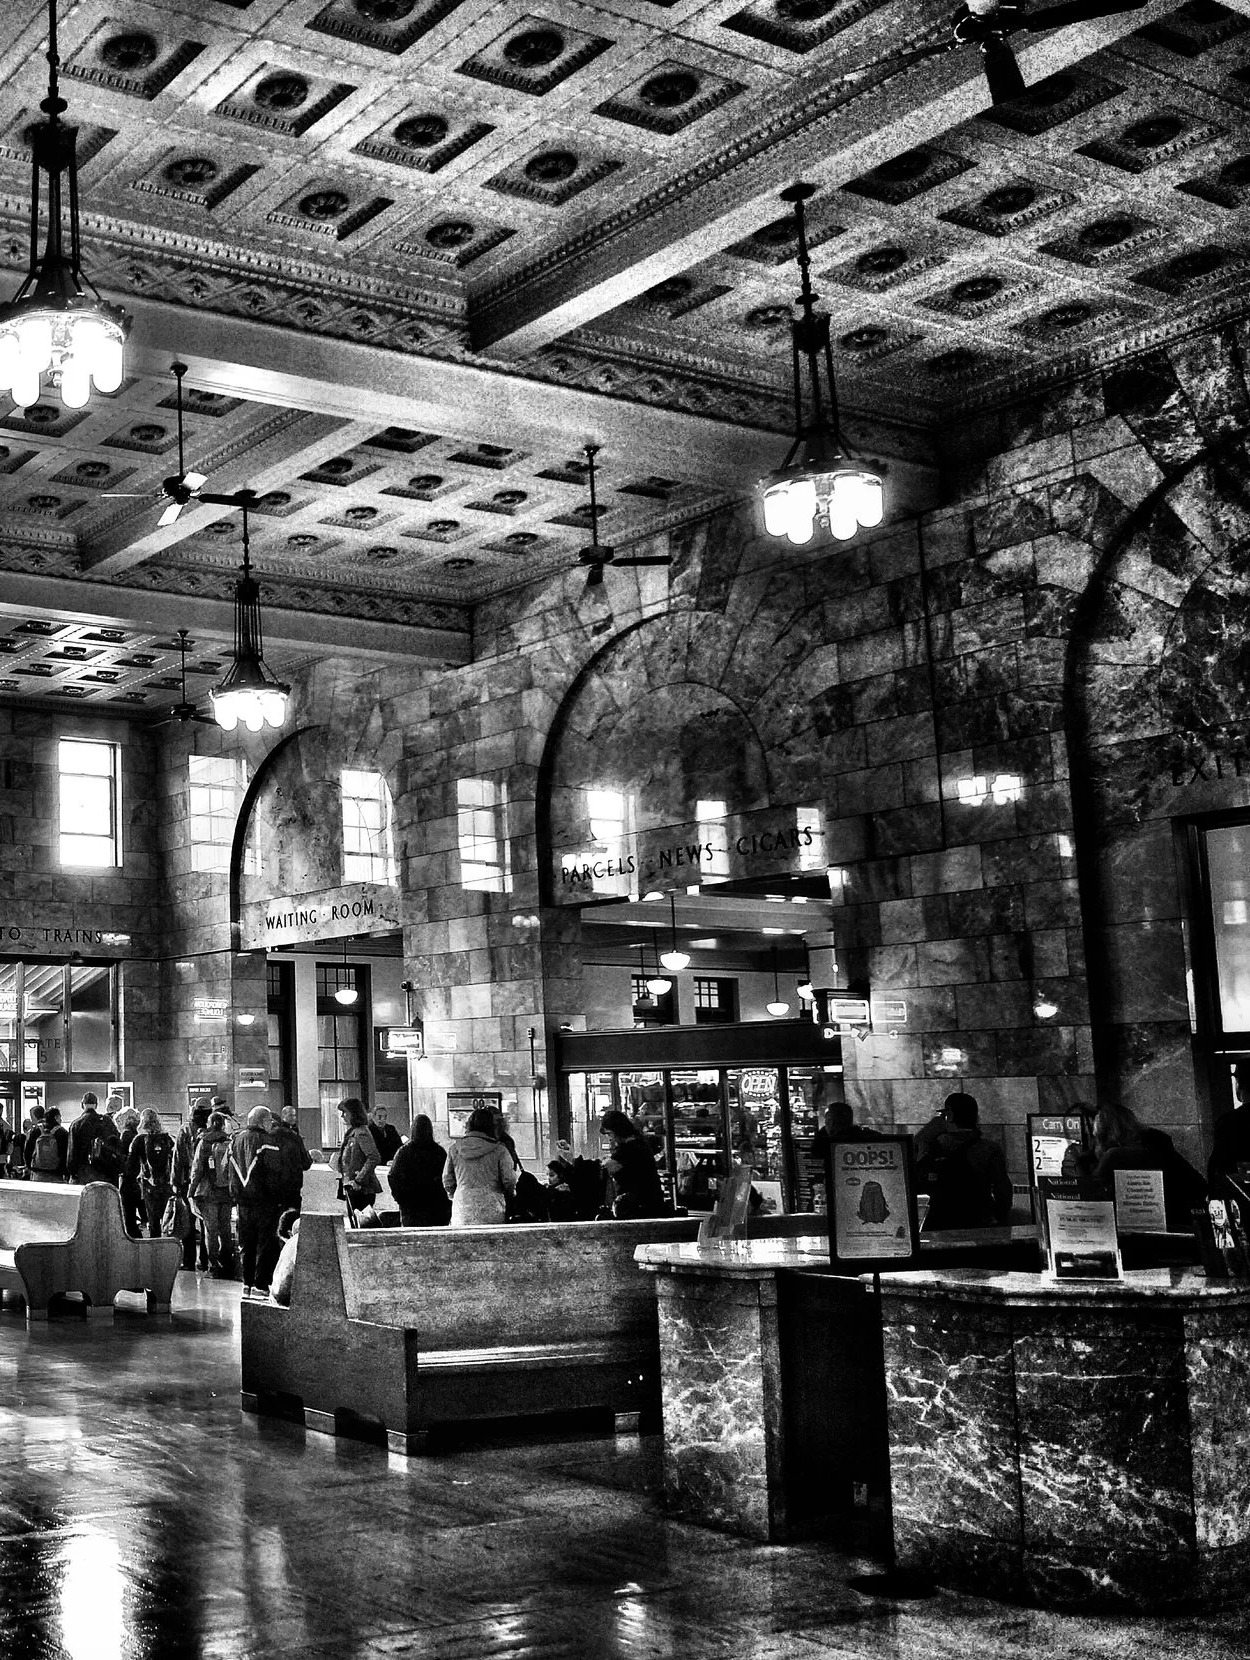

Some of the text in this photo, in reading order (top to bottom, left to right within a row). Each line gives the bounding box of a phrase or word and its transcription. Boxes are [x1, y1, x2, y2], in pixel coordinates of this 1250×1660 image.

[1172, 752, 1245, 786] EXIT
[561, 826, 812, 884] PARCELS NEWS CIGARS
[266, 899, 373, 929] WAITING ROOM
[43, 928, 102, 944] TRAINS
[28, 1039, 61, 1049] GATE
[40, 1051, 47, 1063] 5
[742, 1076, 777, 1093] OPEN
[1043, 1118, 1080, 1132] Carry On
[1034, 1139, 1041, 1153] 2
[843, 1150, 894, 1165] OOPS!
[1035, 1157, 1043, 1170] 2
